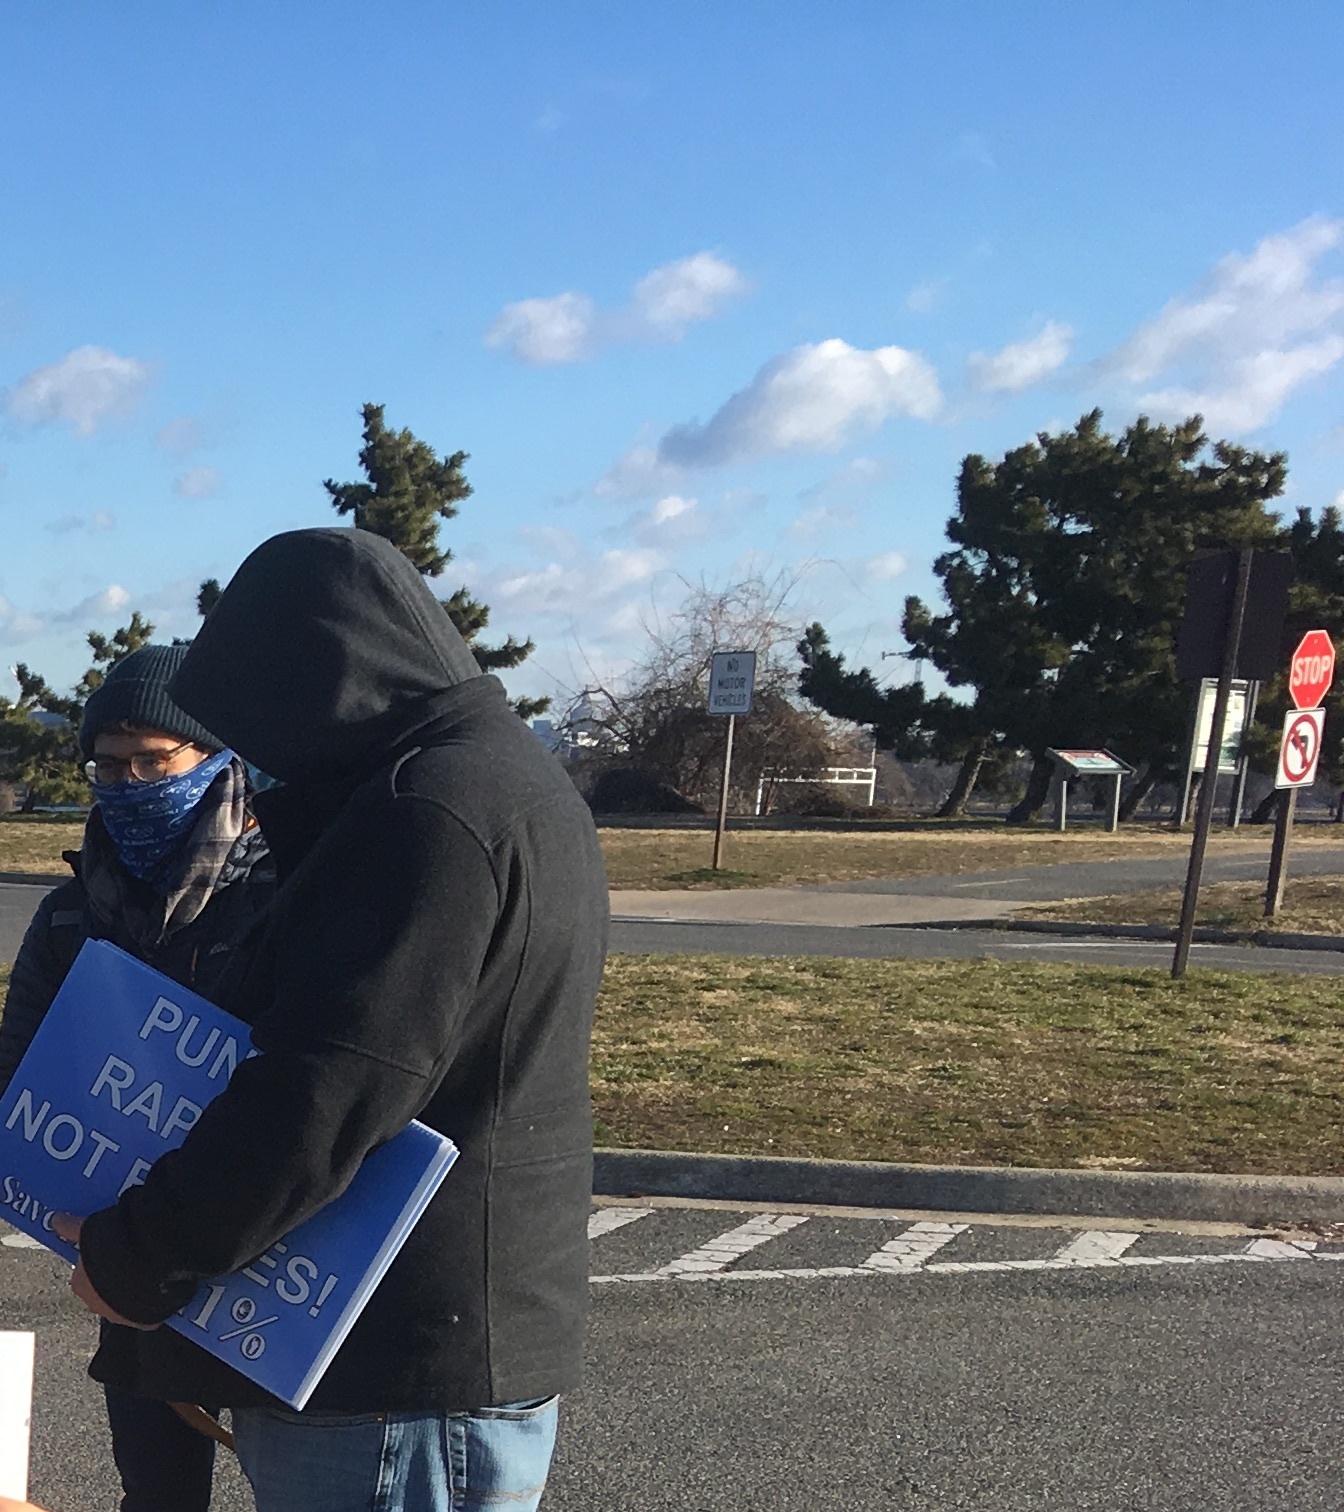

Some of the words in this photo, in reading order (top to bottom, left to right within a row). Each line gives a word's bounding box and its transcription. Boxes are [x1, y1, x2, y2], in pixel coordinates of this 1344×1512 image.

[727, 658, 739, 672] NO
[1293, 655, 1332, 686] STOP
[139, 995, 258, 1080] PUN
[4, 1087, 121, 1179] NOT
[89, 1053, 204, 1140] RAP
[180, 1283, 279, 1360] 1%
